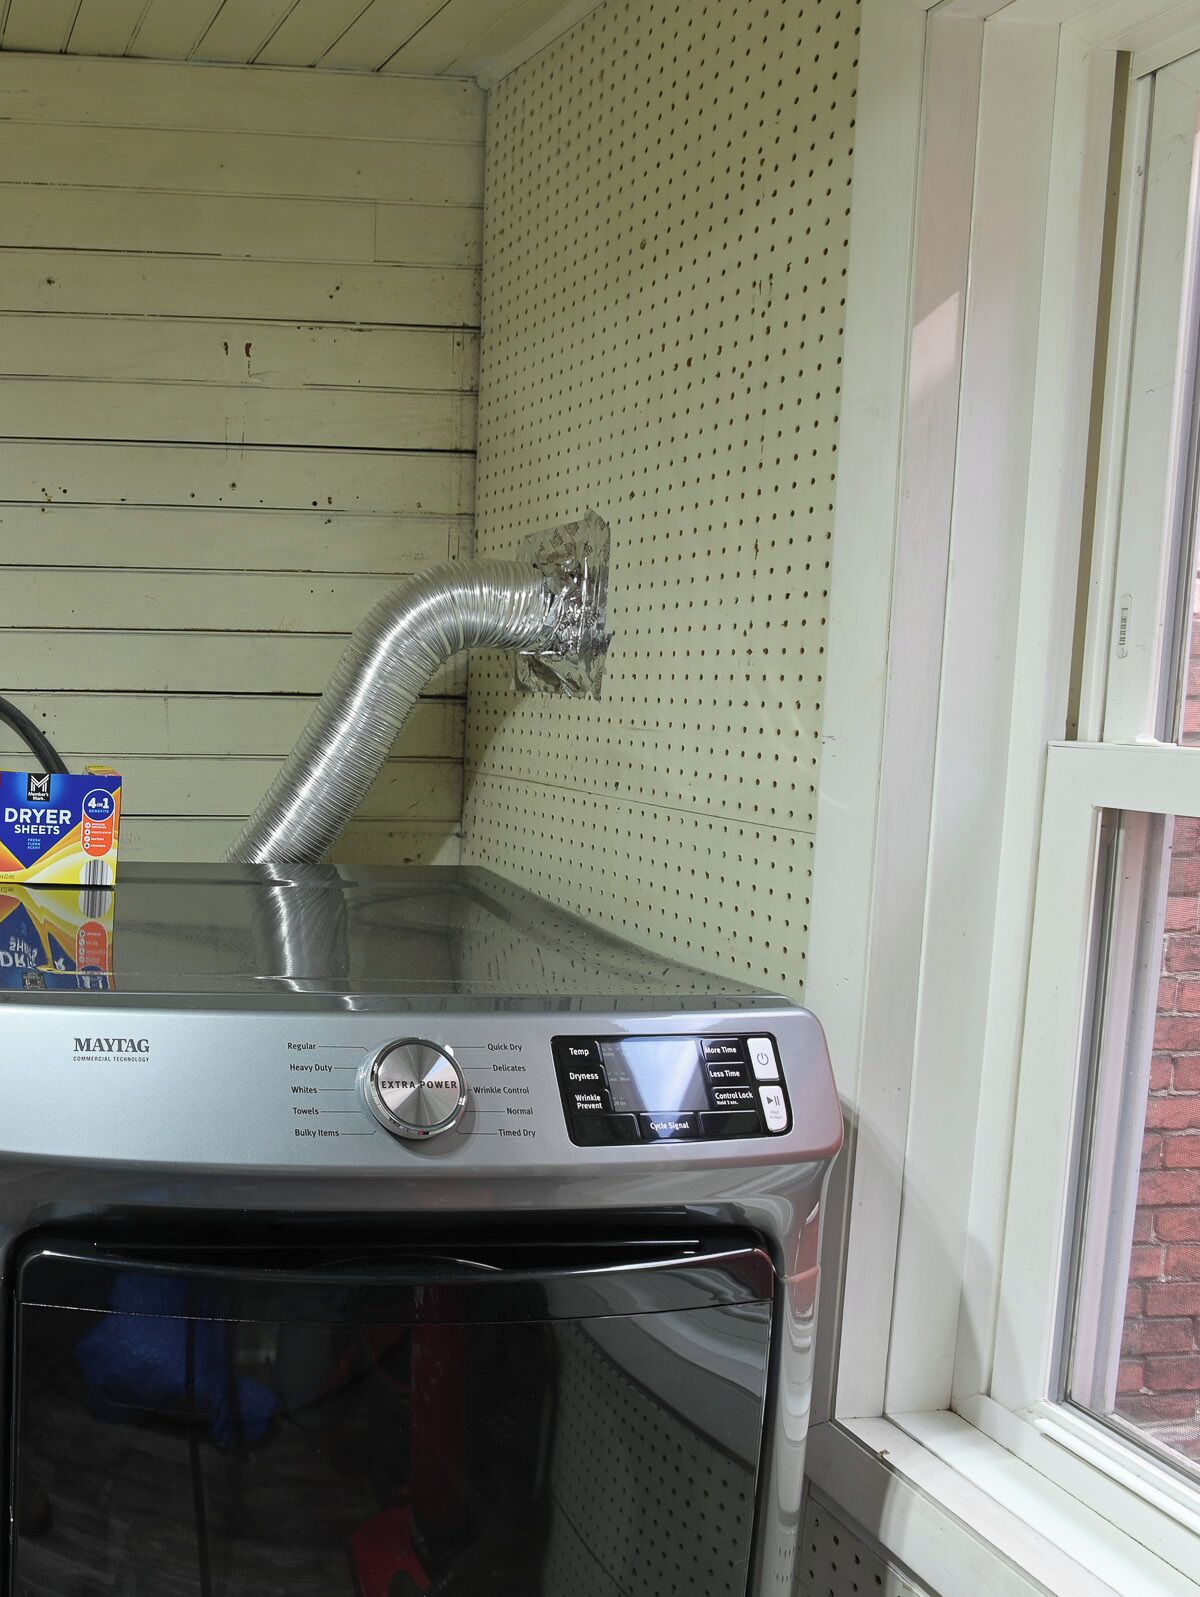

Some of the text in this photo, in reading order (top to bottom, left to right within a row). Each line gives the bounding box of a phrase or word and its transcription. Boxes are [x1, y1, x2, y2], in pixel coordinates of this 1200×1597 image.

[5, 808, 72, 824] DRYER
[14, 824, 60, 835] SHEETS
[73, 1038, 150, 1053] MAYTAG
[288, 1043, 316, 1051] Regular
[487, 1044, 522, 1052] Quick Dry
[569, 1048, 589, 1057] Temp
[721, 1046, 737, 1054] Time
[290, 1064, 333, 1073] Heavy Duty
[492, 1064, 526, 1072] Delicates
[569, 1072, 599, 1081] Dryness
[710, 1070, 725, 1078] Less
[381, 1081, 458, 1089] EXTRA POWER
[291, 1086, 318, 1094] Whites
[473, 1086, 529, 1094] Wrinkle Control
[574, 1094, 601, 1102] Wrinkle
[715, 1092, 738, 1100] Control
[650, 1122, 689, 1131] Cycle Signal
[294, 1129, 340, 1138] Bulky Items
[498, 1129, 536, 1138] Timed Dry
